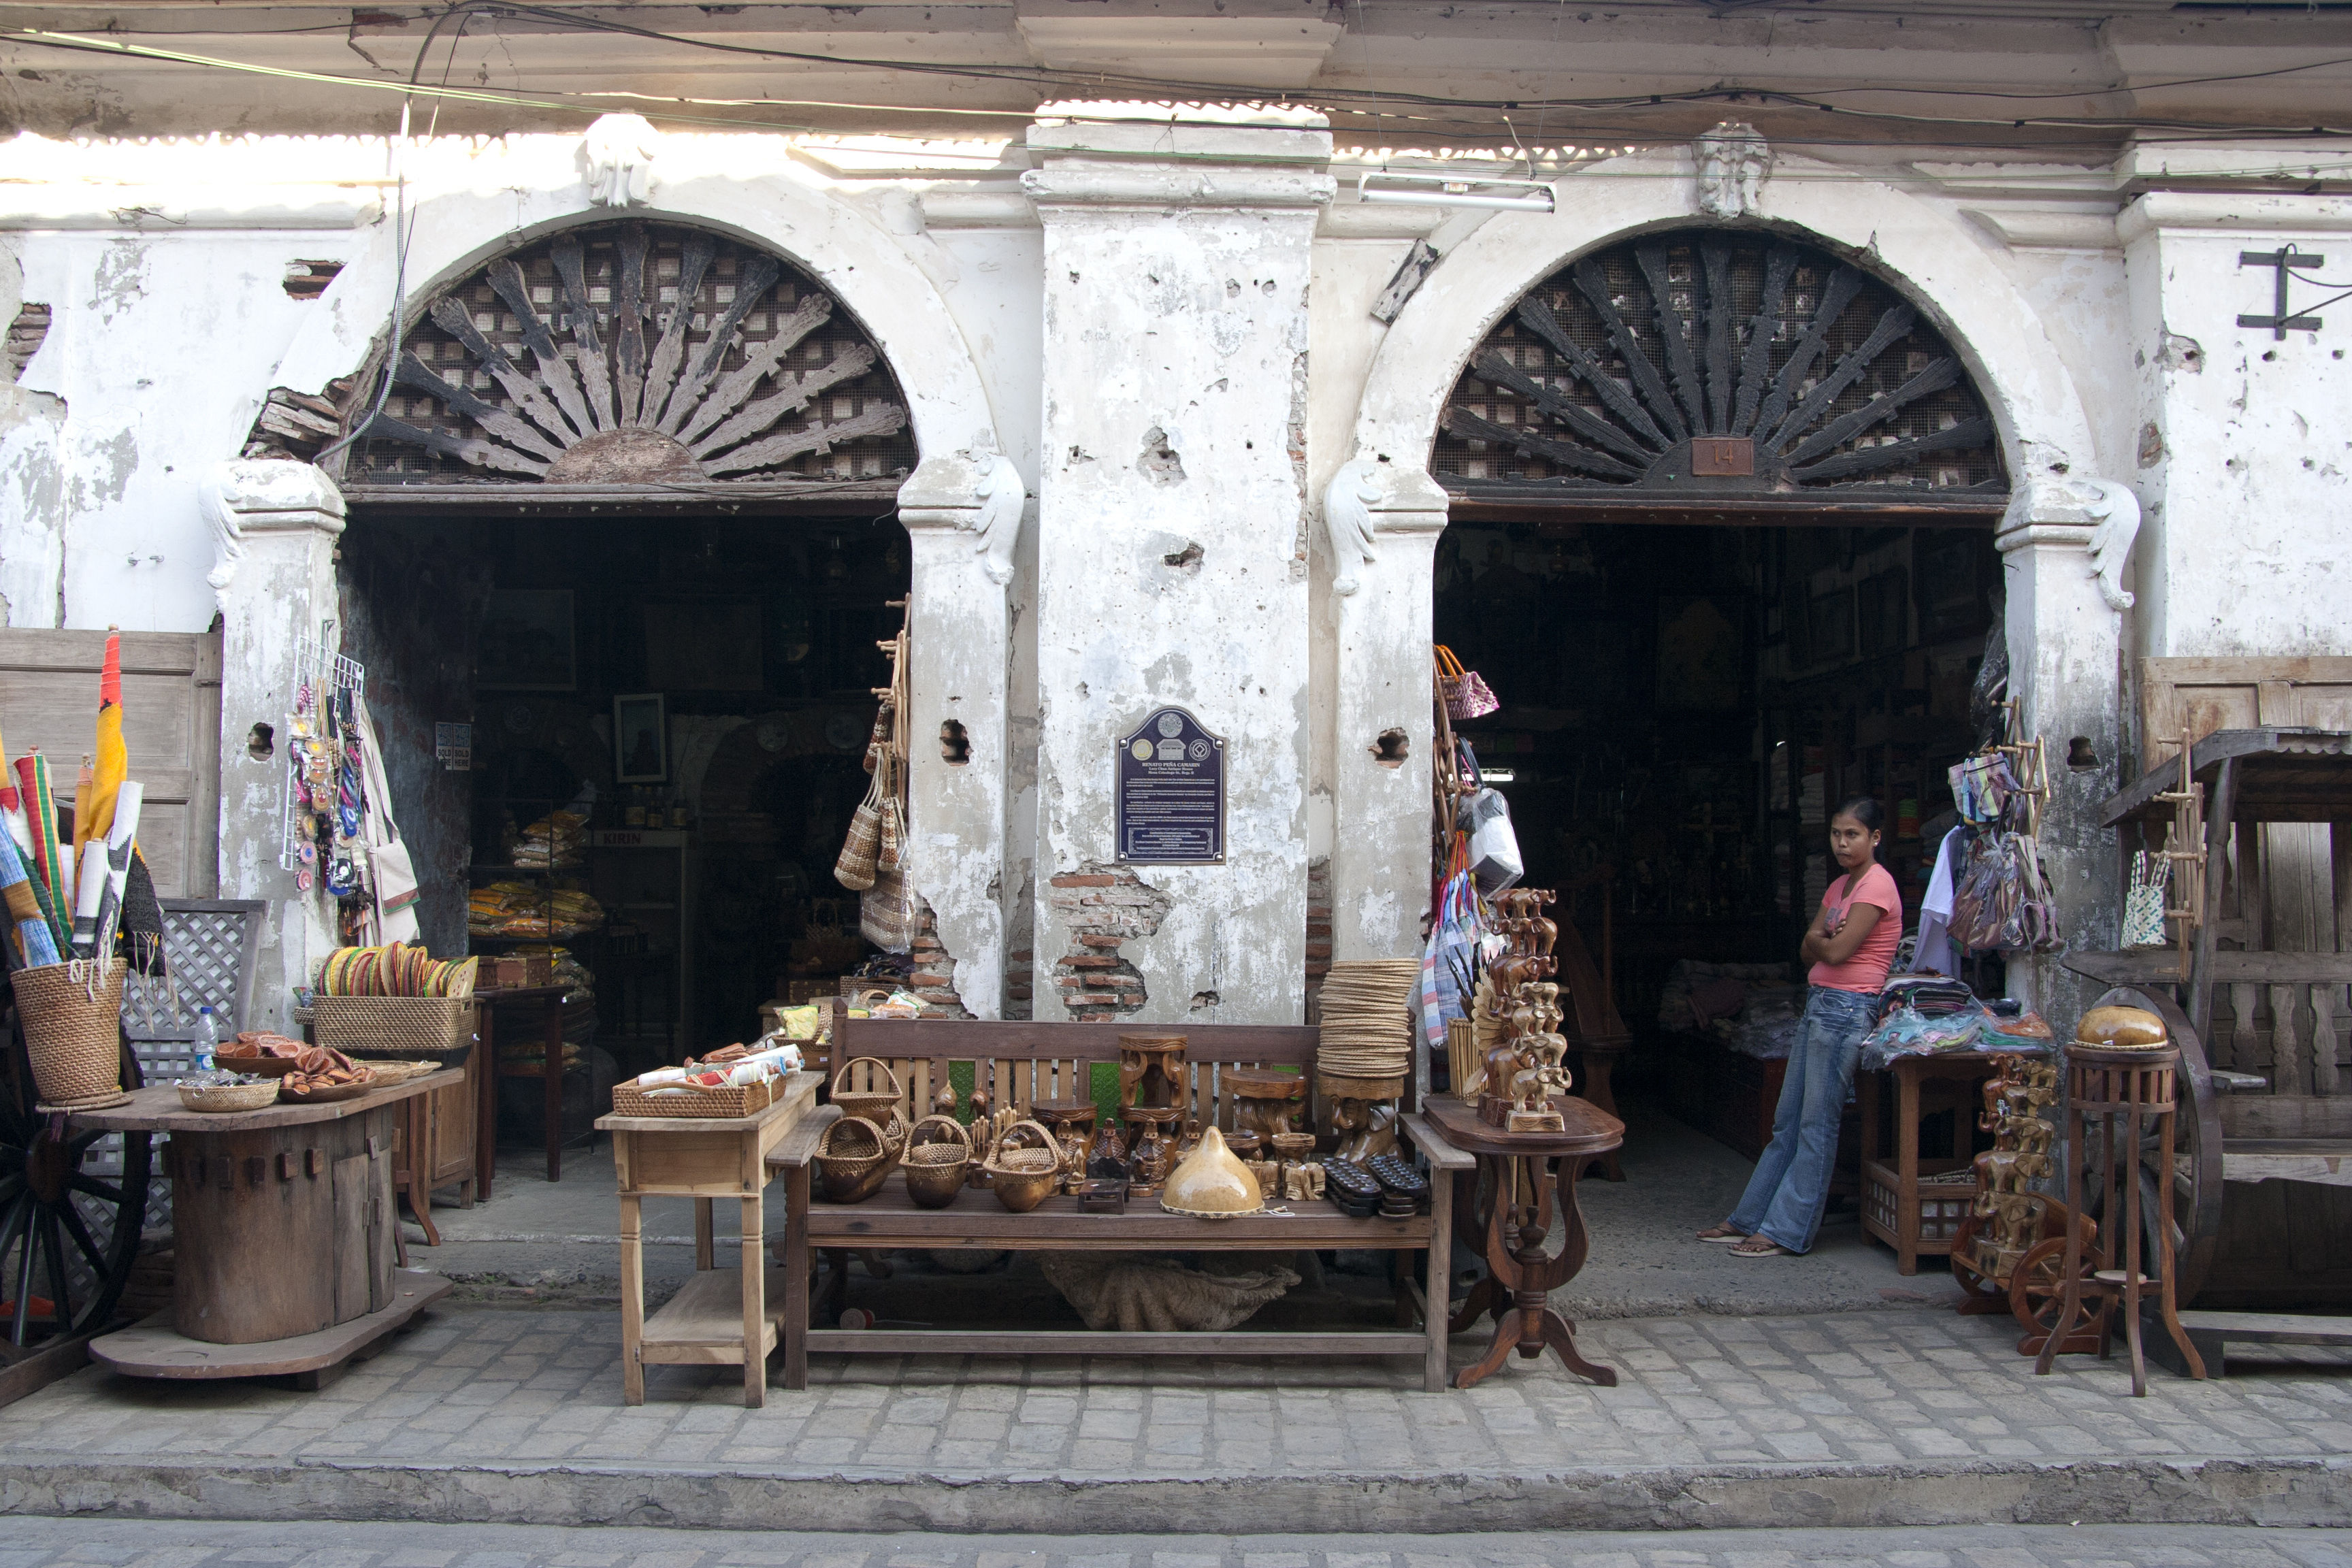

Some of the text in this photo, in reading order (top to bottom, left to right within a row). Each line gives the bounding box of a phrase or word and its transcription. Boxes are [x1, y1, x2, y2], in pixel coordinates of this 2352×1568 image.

[1712, 441, 1733, 465] 14
[438, 749, 451, 757] SOLD
[454, 759, 469, 767] HERE
[604, 832, 641, 845] KIRIN
